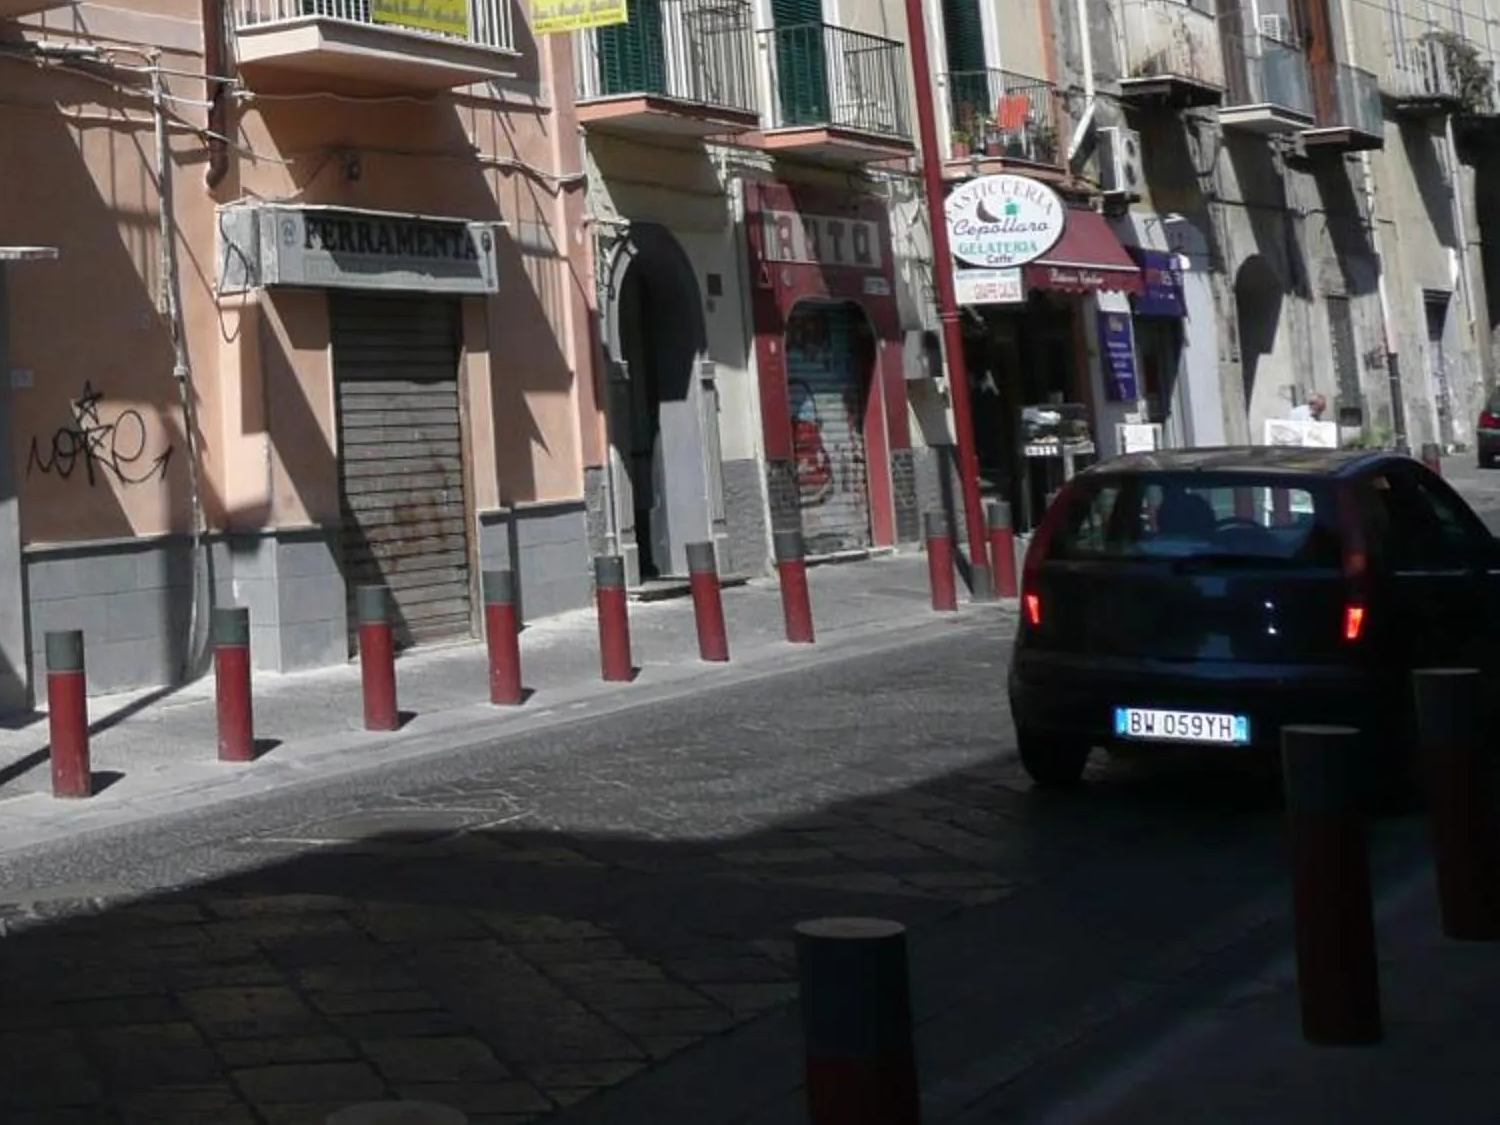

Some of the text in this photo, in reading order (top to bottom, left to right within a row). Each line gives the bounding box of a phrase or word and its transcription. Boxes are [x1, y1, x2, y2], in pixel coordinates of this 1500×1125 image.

[303, 218, 480, 261] FERRAMENTA
[958, 240, 1038, 255] GELATERIA
[1131, 711, 1232, 738] BW 059YH
